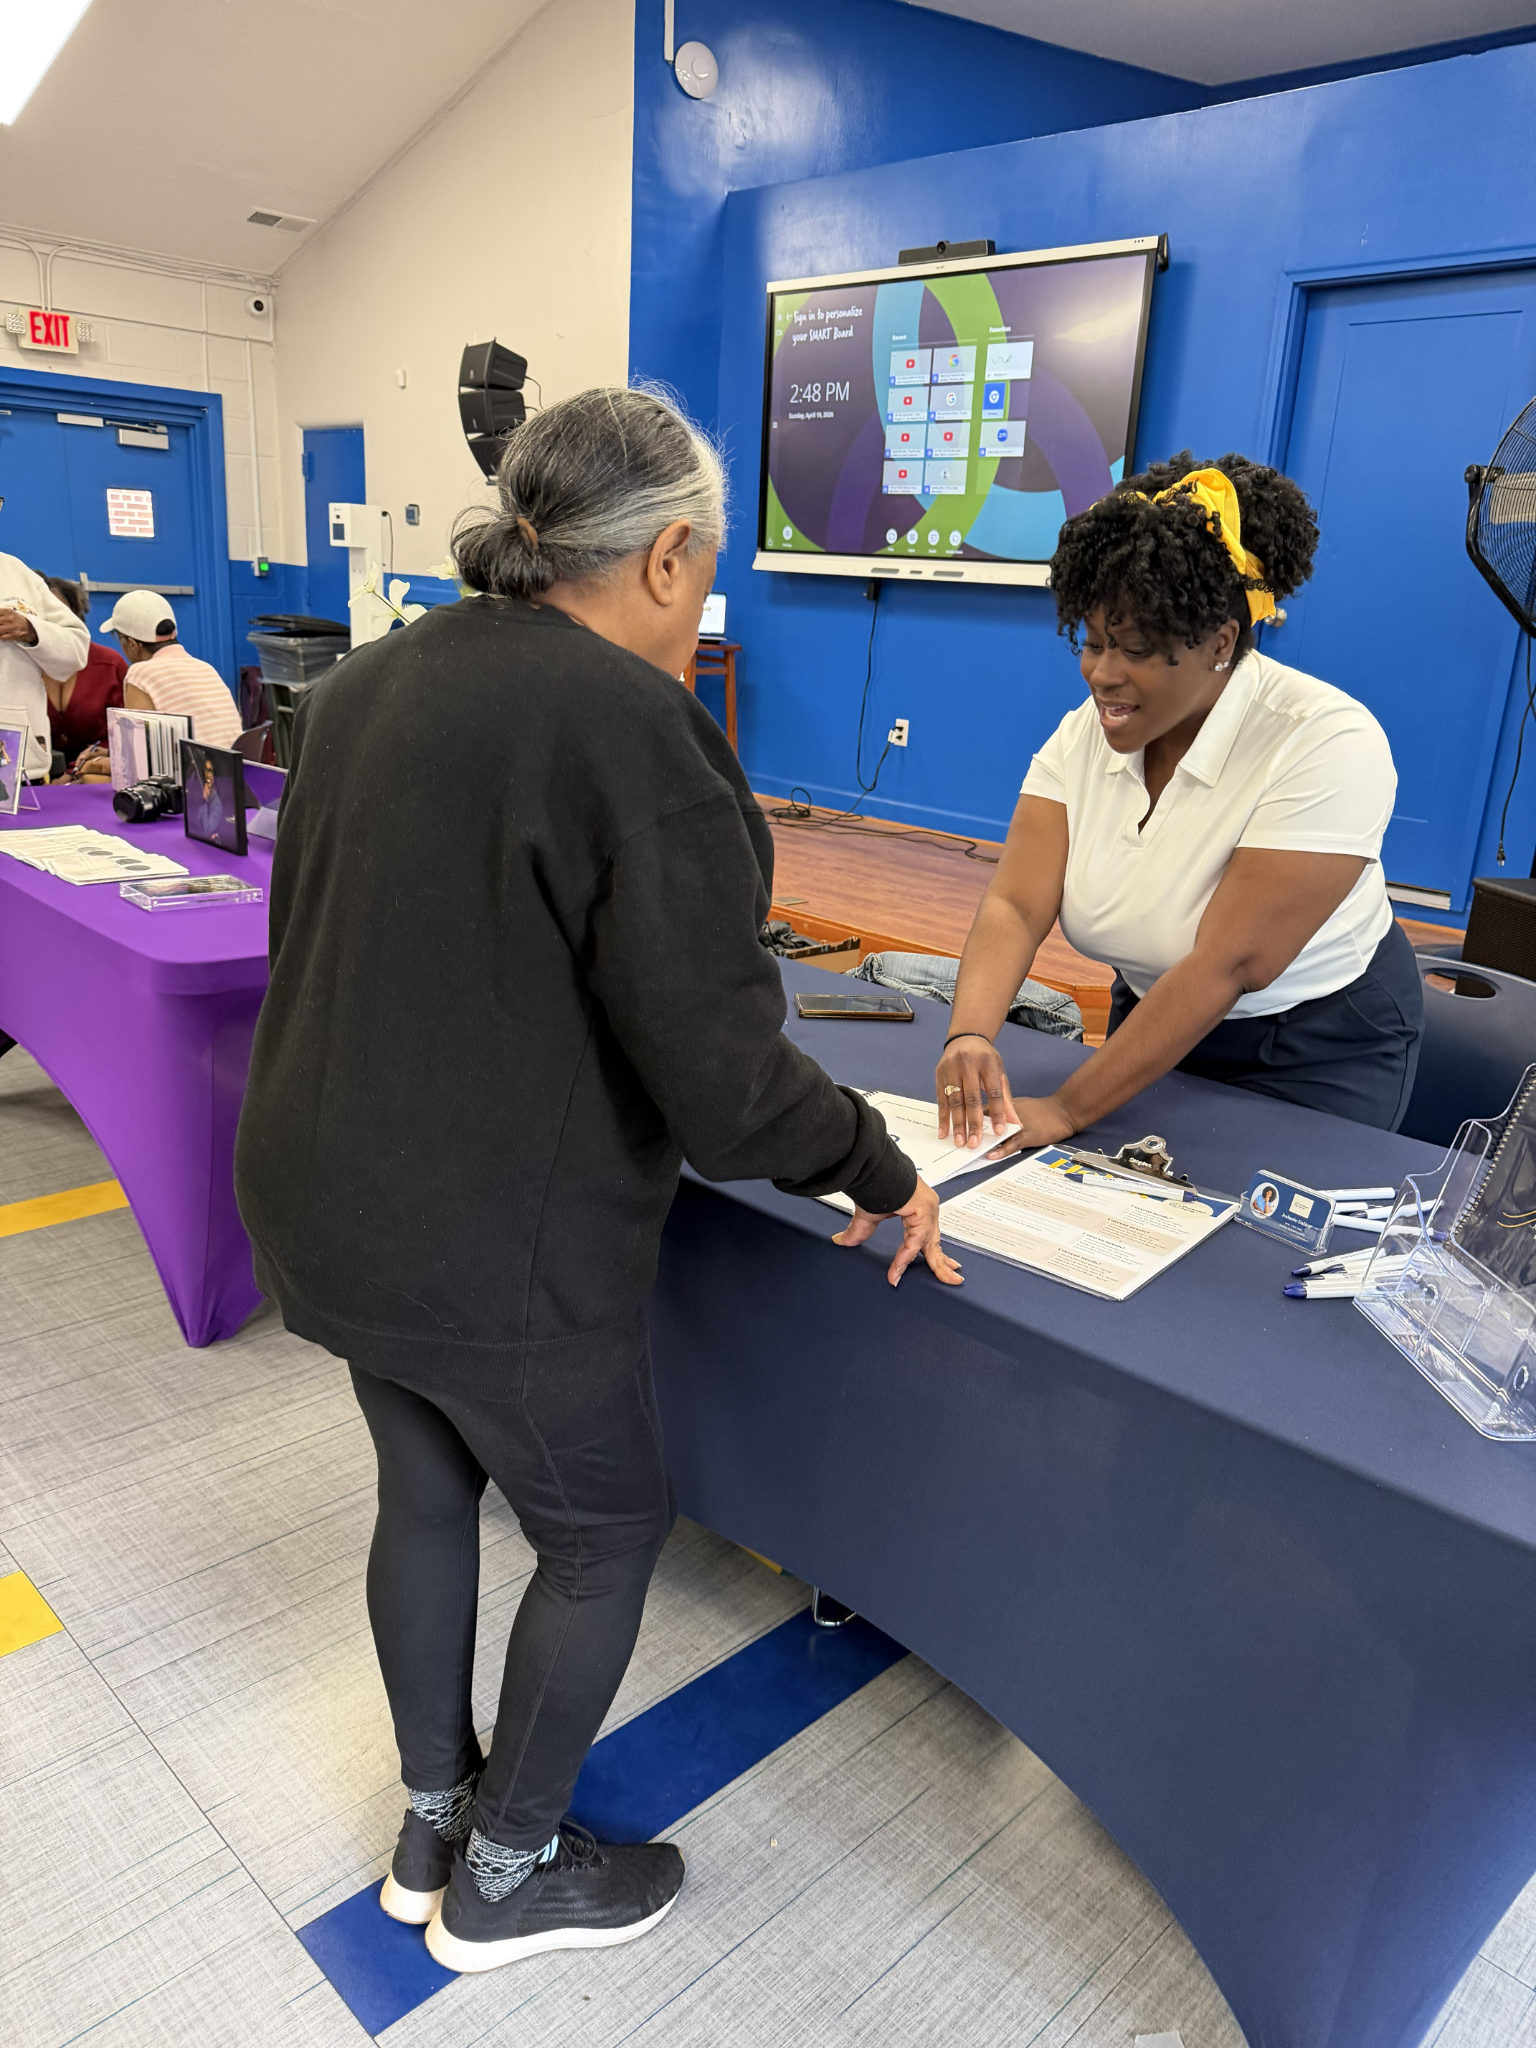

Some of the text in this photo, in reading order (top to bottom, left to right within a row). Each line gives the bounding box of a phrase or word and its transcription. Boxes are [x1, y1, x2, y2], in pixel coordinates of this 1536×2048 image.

[794, 306, 863, 326] Sign in to personalize
[29, 311, 70, 347] EXIT
[792, 325, 853, 346] your SMART Board
[790, 381, 850, 404] 2:48 PM
